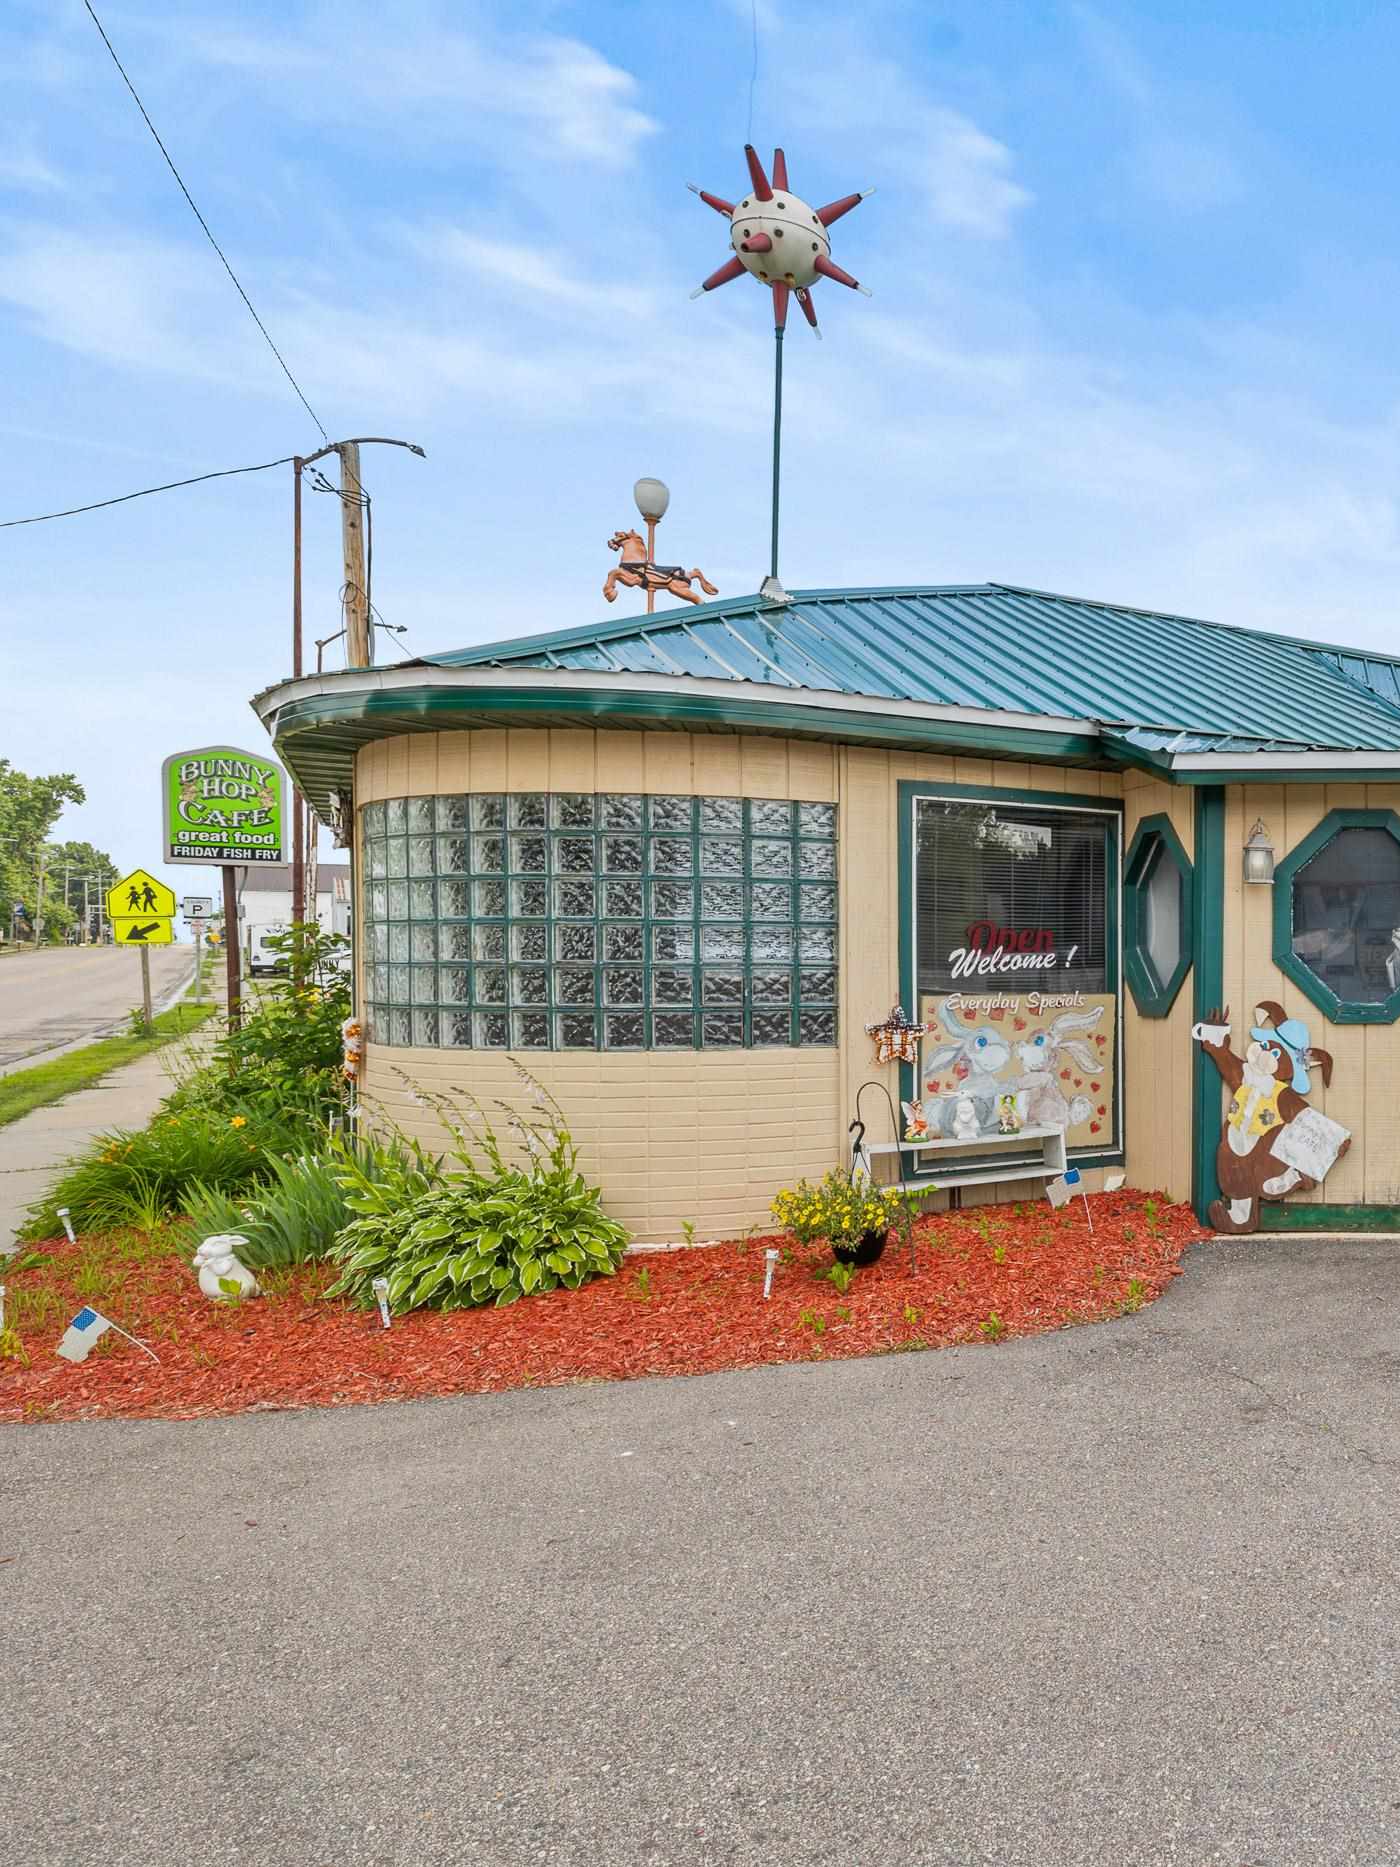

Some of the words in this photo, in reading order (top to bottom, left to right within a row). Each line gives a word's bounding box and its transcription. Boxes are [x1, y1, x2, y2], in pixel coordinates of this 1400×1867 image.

[179, 759, 273, 787] BUNNY
[201, 777, 257, 802] HOP
[177, 799, 273, 828] CAFE
[177, 830, 229, 844] great
[233, 831, 276, 845] food
[173, 845, 220, 857] FRIDAY
[223, 848, 252, 858] FISH
[255, 849, 280, 860] FRY
[964, 919, 1056, 957] Open
[948, 945, 1057, 980] Welcome
[946, 991, 1020, 1016] Everyday
[1025, 990, 1086, 1016] Specials
